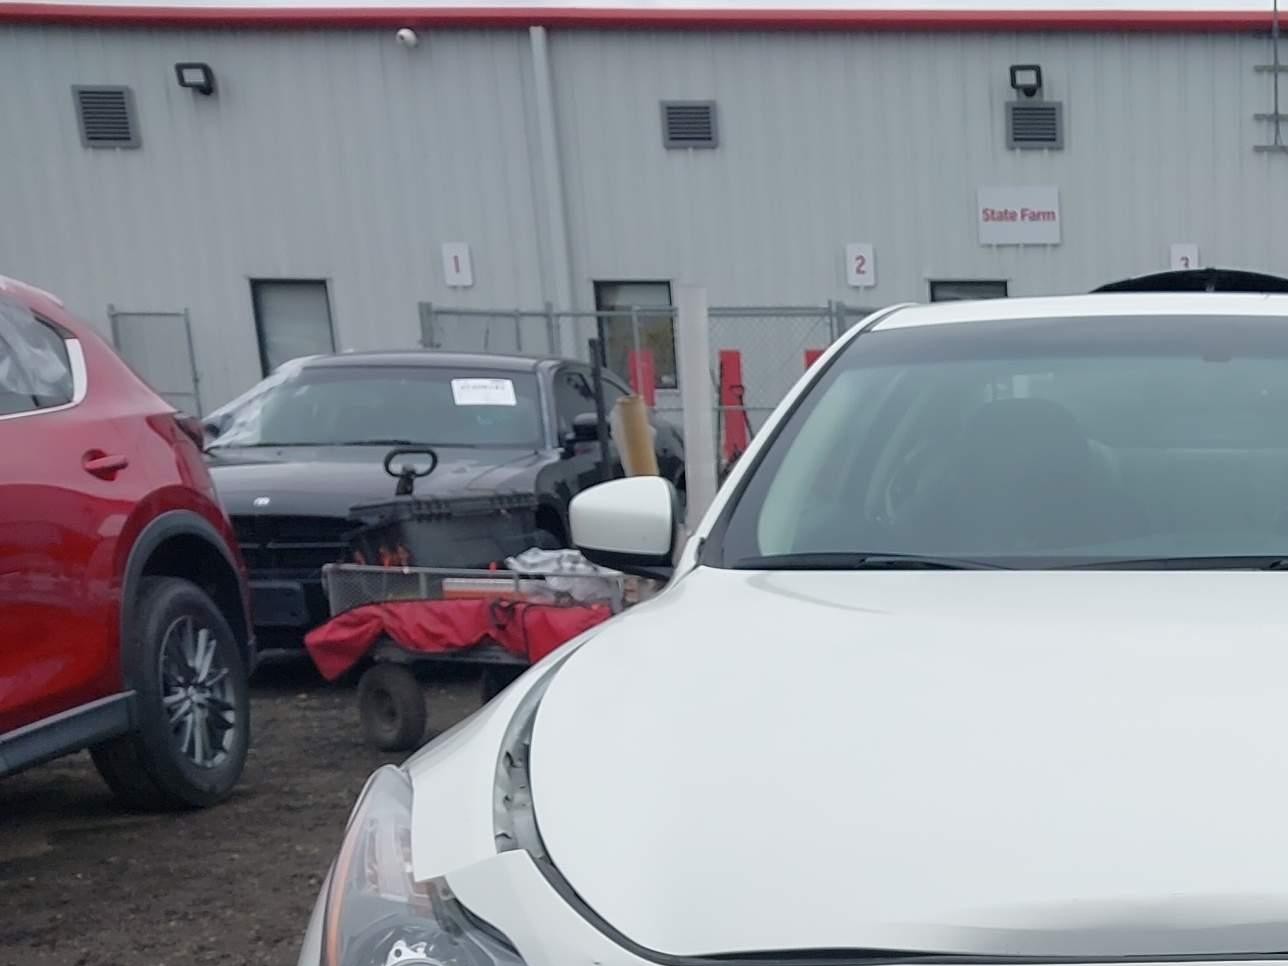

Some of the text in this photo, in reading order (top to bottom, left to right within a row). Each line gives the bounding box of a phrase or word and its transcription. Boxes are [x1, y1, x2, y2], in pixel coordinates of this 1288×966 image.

[982, 207, 1057, 222] State Farm
[855, 255, 866, 275] 2
